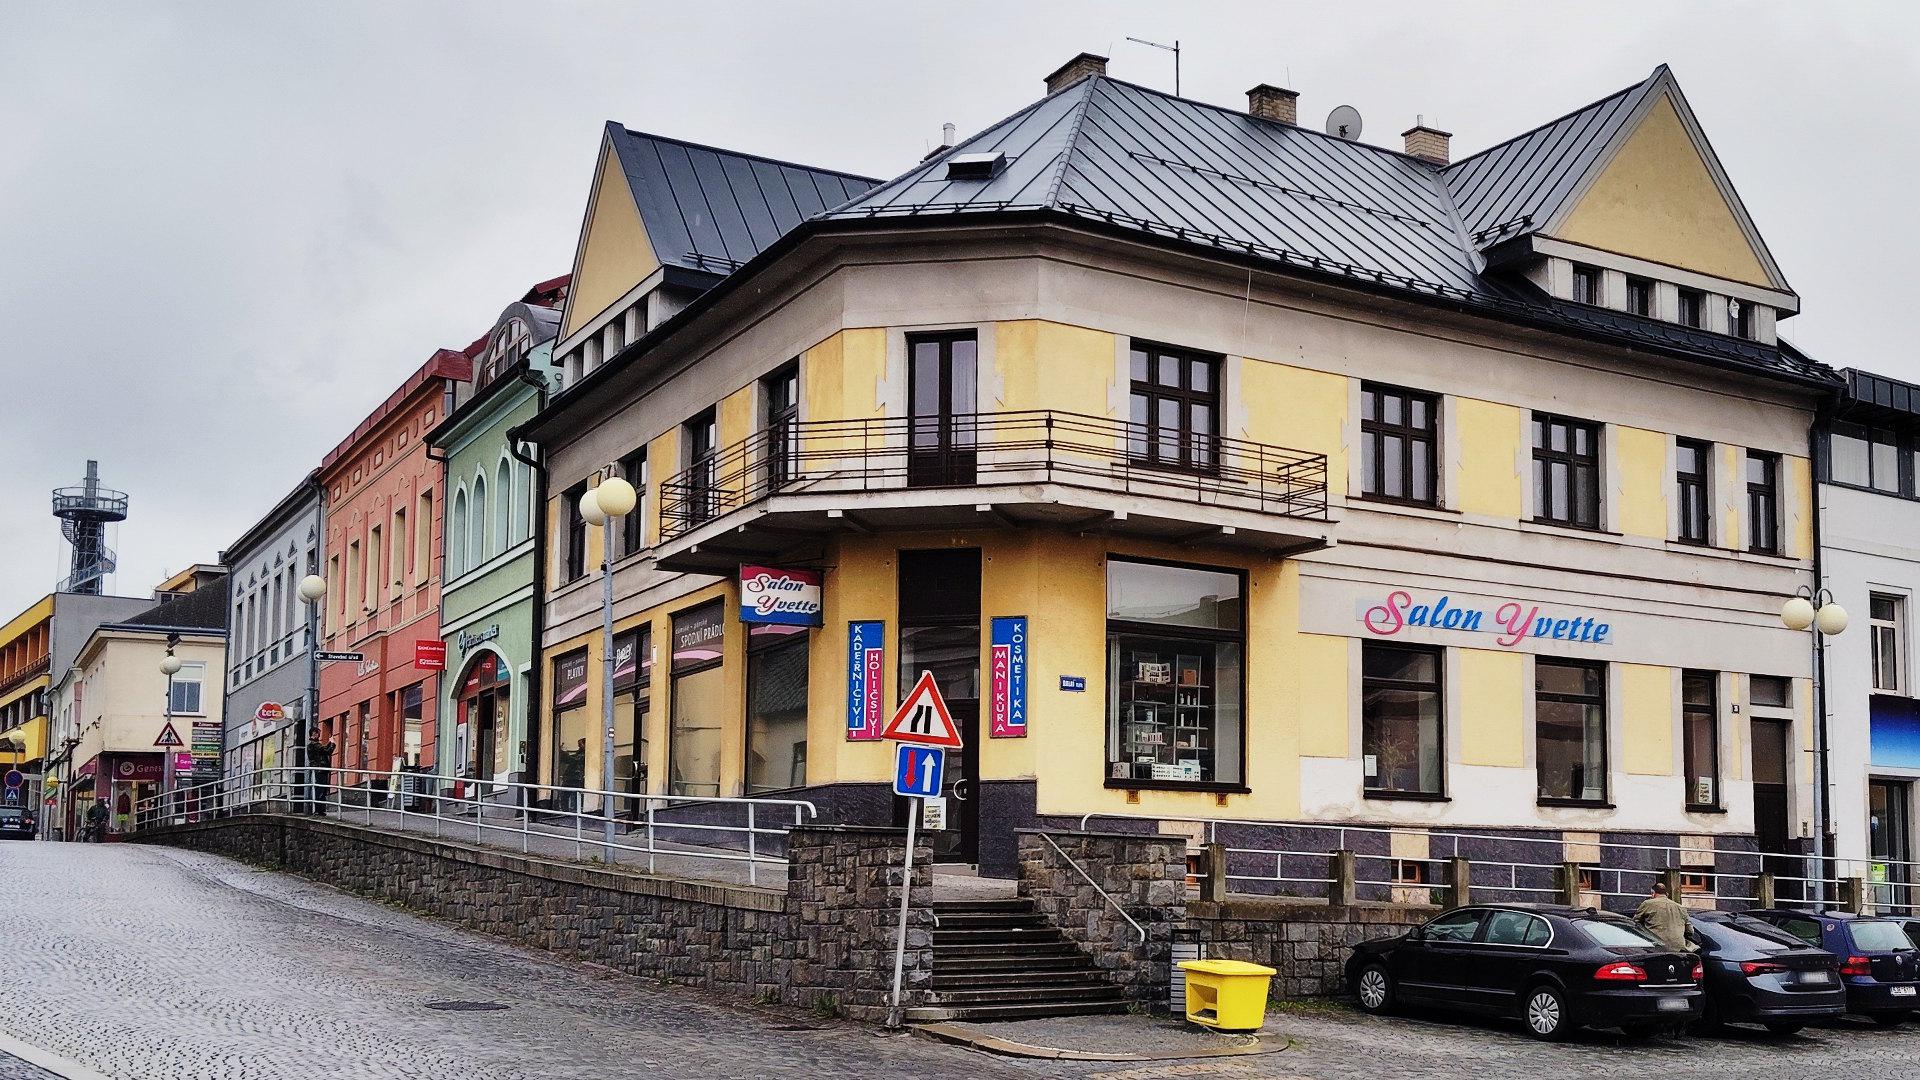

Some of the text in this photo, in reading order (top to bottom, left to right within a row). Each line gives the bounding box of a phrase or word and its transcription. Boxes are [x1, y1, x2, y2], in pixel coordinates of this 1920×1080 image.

[747, 575, 804, 592] Salon
[757, 595, 817, 613] Yvette
[1364, 590, 1610, 646] Salon Yvette
[852, 625, 863, 726] KADEŘNICTVÍ
[869, 652, 880, 737] HOLIČSTVÍ
[1012, 623, 1024, 719] KOSMETIKA
[262, 709, 282, 717] teta
